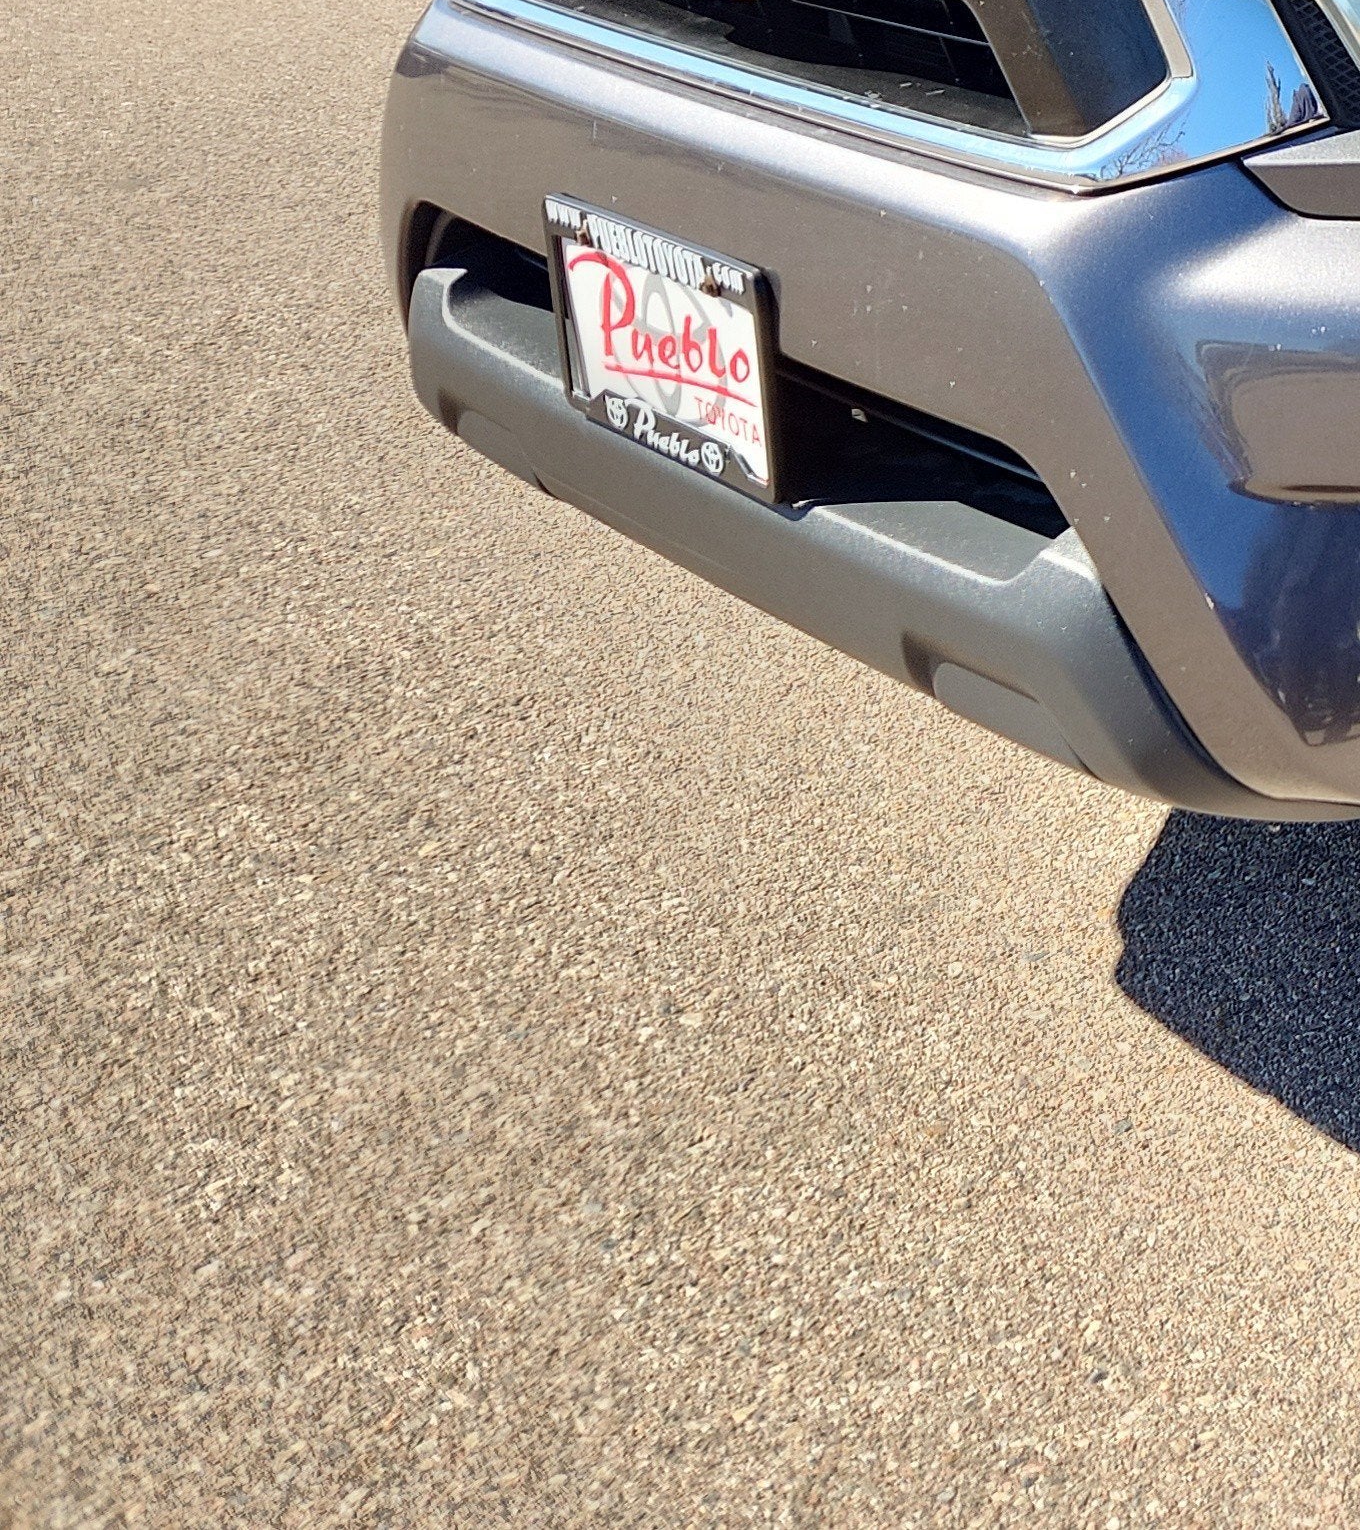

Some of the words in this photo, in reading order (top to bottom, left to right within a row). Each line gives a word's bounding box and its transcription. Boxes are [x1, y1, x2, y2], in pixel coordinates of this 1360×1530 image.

[568, 250, 750, 383] Pueblo
[624, 397, 701, 467] Pueblo
[694, 395, 762, 448] TOYOTA
